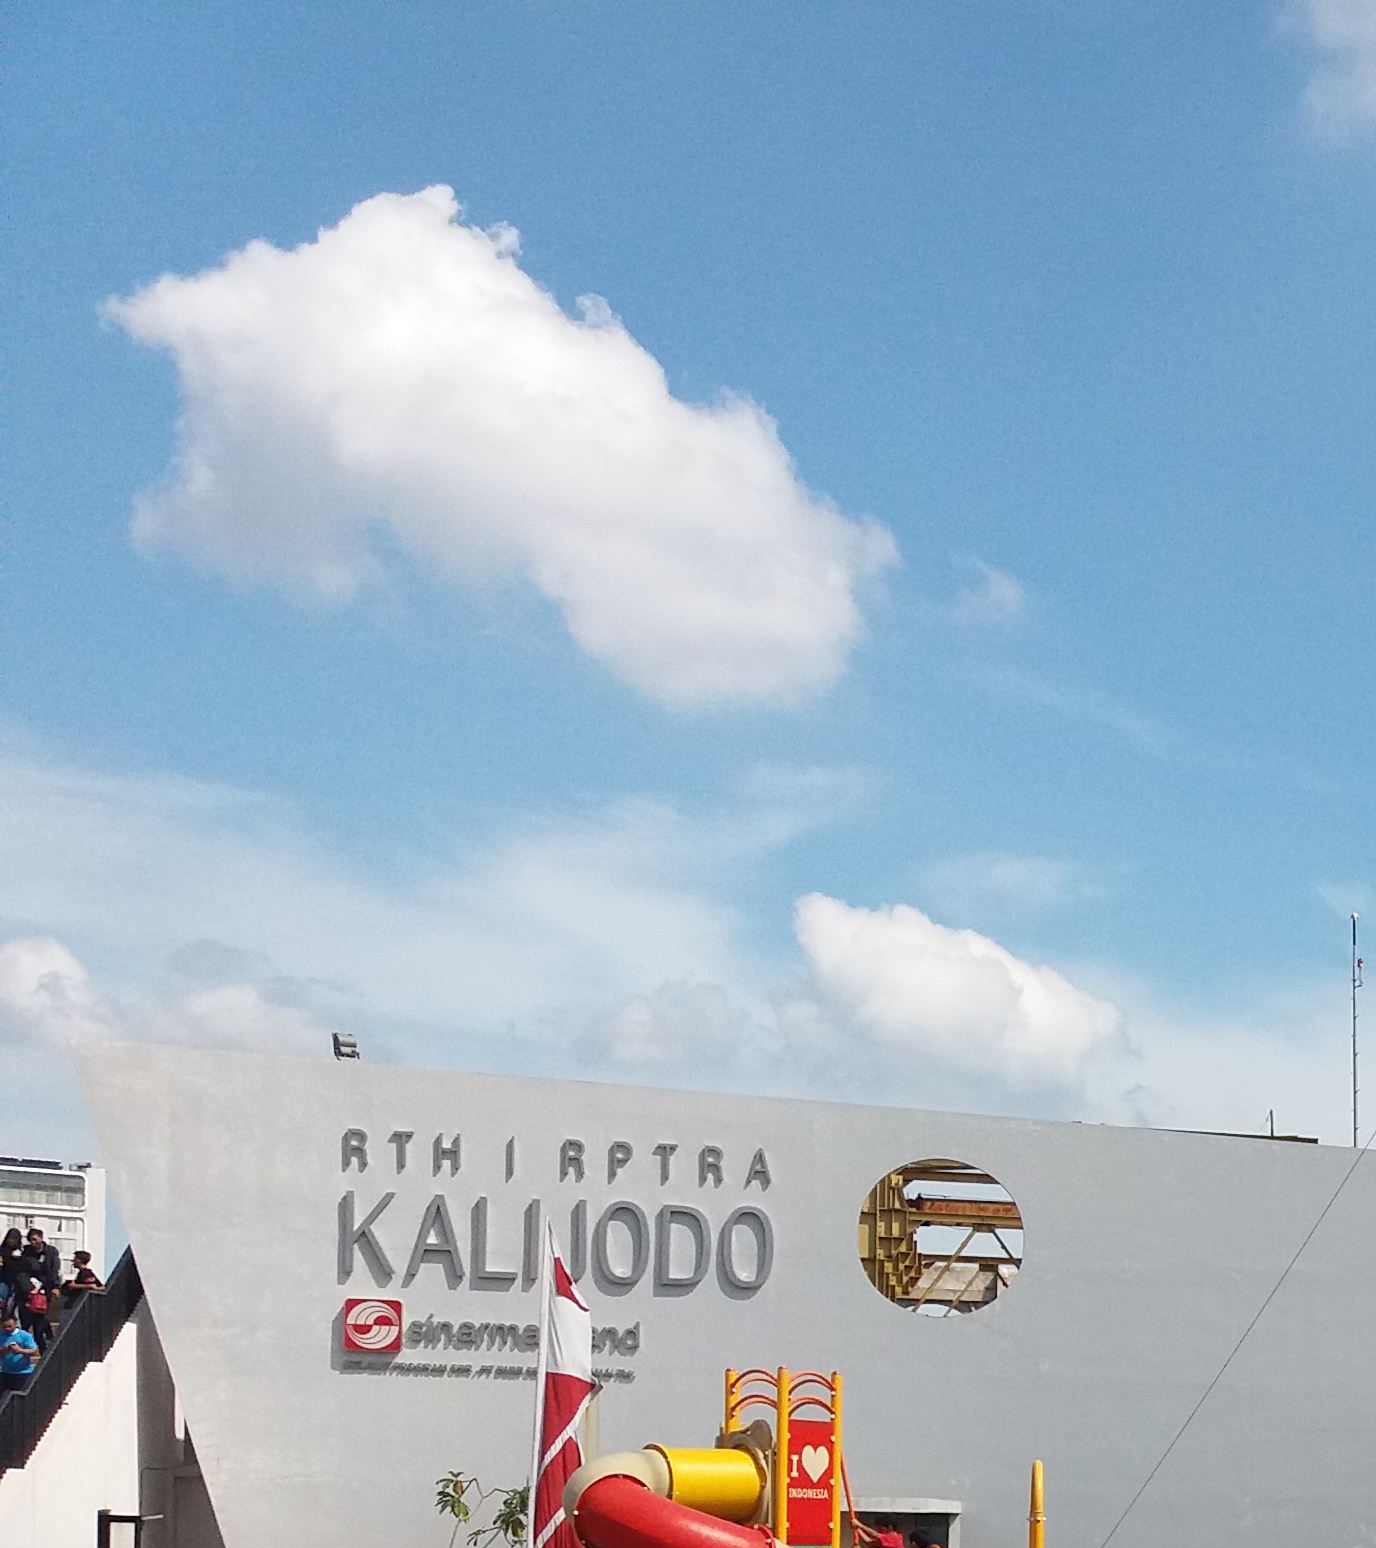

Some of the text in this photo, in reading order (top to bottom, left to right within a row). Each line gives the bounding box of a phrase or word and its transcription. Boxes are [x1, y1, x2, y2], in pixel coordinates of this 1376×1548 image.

[341, 1128, 462, 1177] RTH
[559, 1138, 772, 1191] RPTRA
[790, 1454, 799, 1478] I
[789, 1487, 829, 1499] INDONESIA
